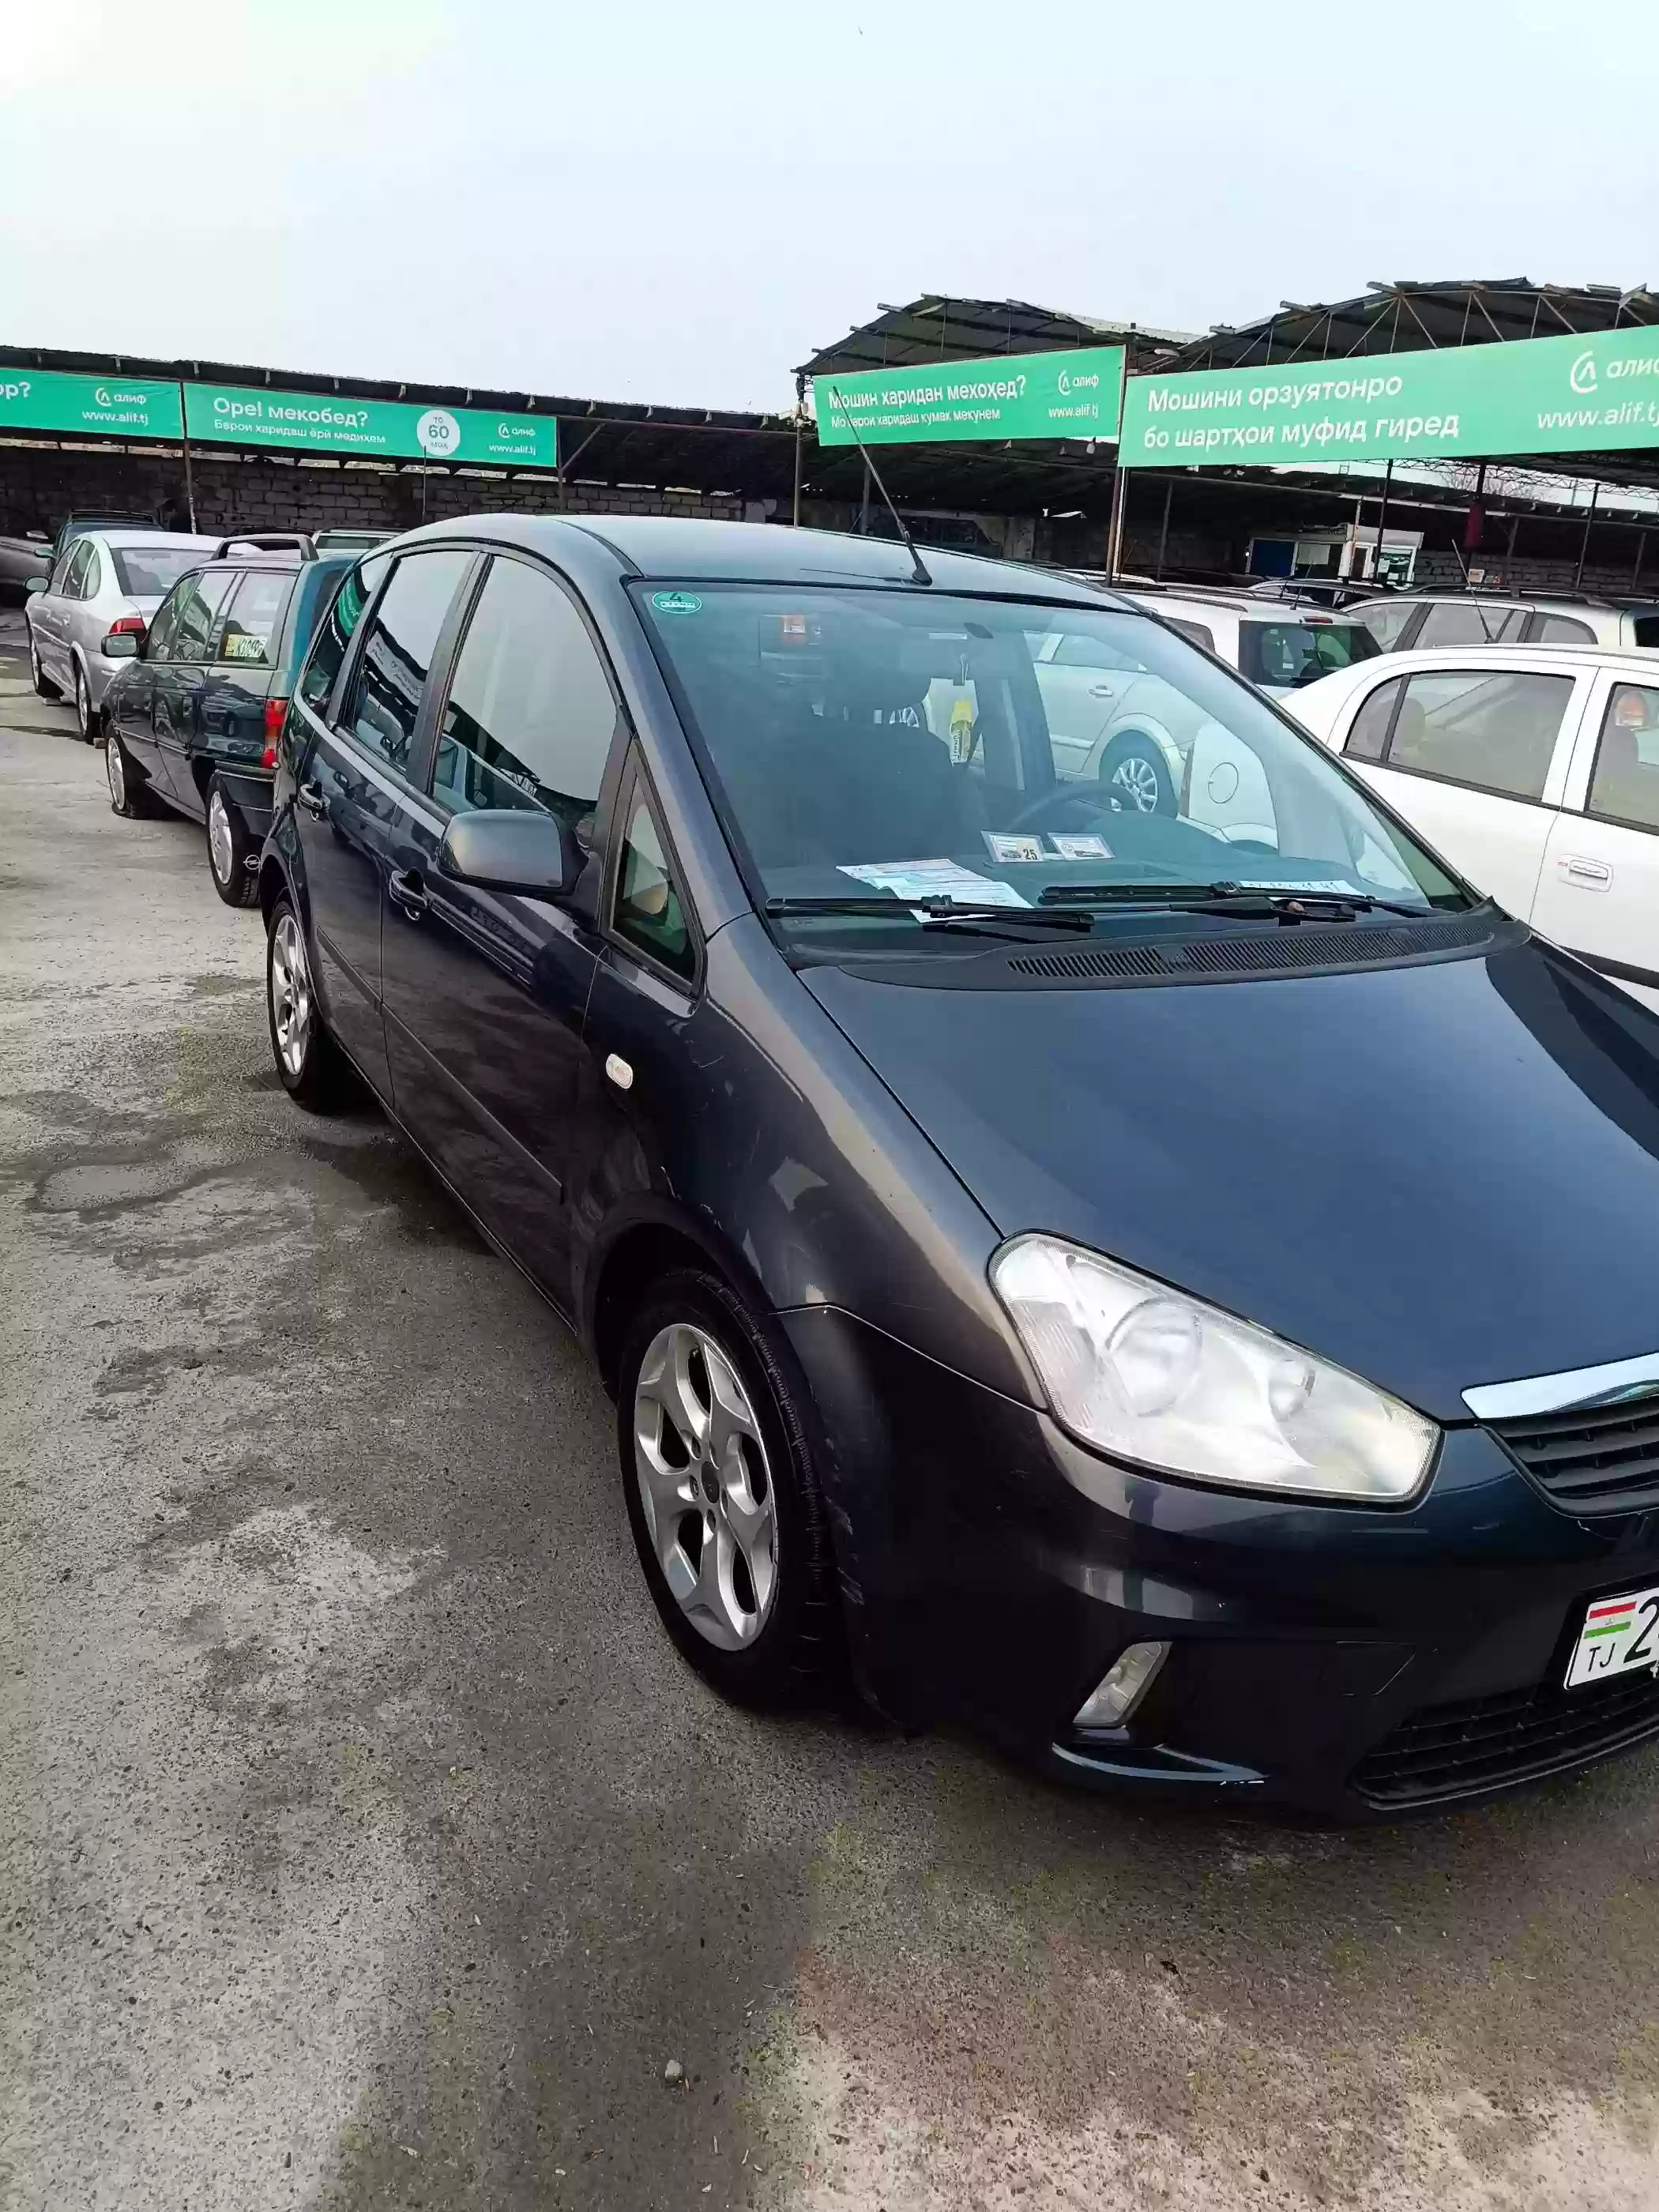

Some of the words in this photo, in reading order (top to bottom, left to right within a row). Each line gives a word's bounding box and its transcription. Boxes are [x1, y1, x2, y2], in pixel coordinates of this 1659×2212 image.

[829, 390, 878, 409] Мошин
[882, 386, 943, 408] харидан
[947, 374, 1026, 401] мехоҳед?
[1073, 374, 1099, 389] алиф
[114, 394, 146, 405] алиф
[1147, 389, 1243, 412] Мошини
[1248, 375, 1403, 411] орзуятонро
[213, 397, 262, 417] Opel
[269, 405, 368, 428] мекобед?
[214, 419, 253, 431] Барои
[428, 424, 449, 438] 60
[1144, 426, 1169, 448] бо
[1175, 425, 1275, 453] шартҳои
[1281, 416, 1367, 448] муфид
[1374, 415, 1460, 442] гиред
[1023, 848, 1038, 860] 25
[1588, 1643, 1616, 1672] TJ
